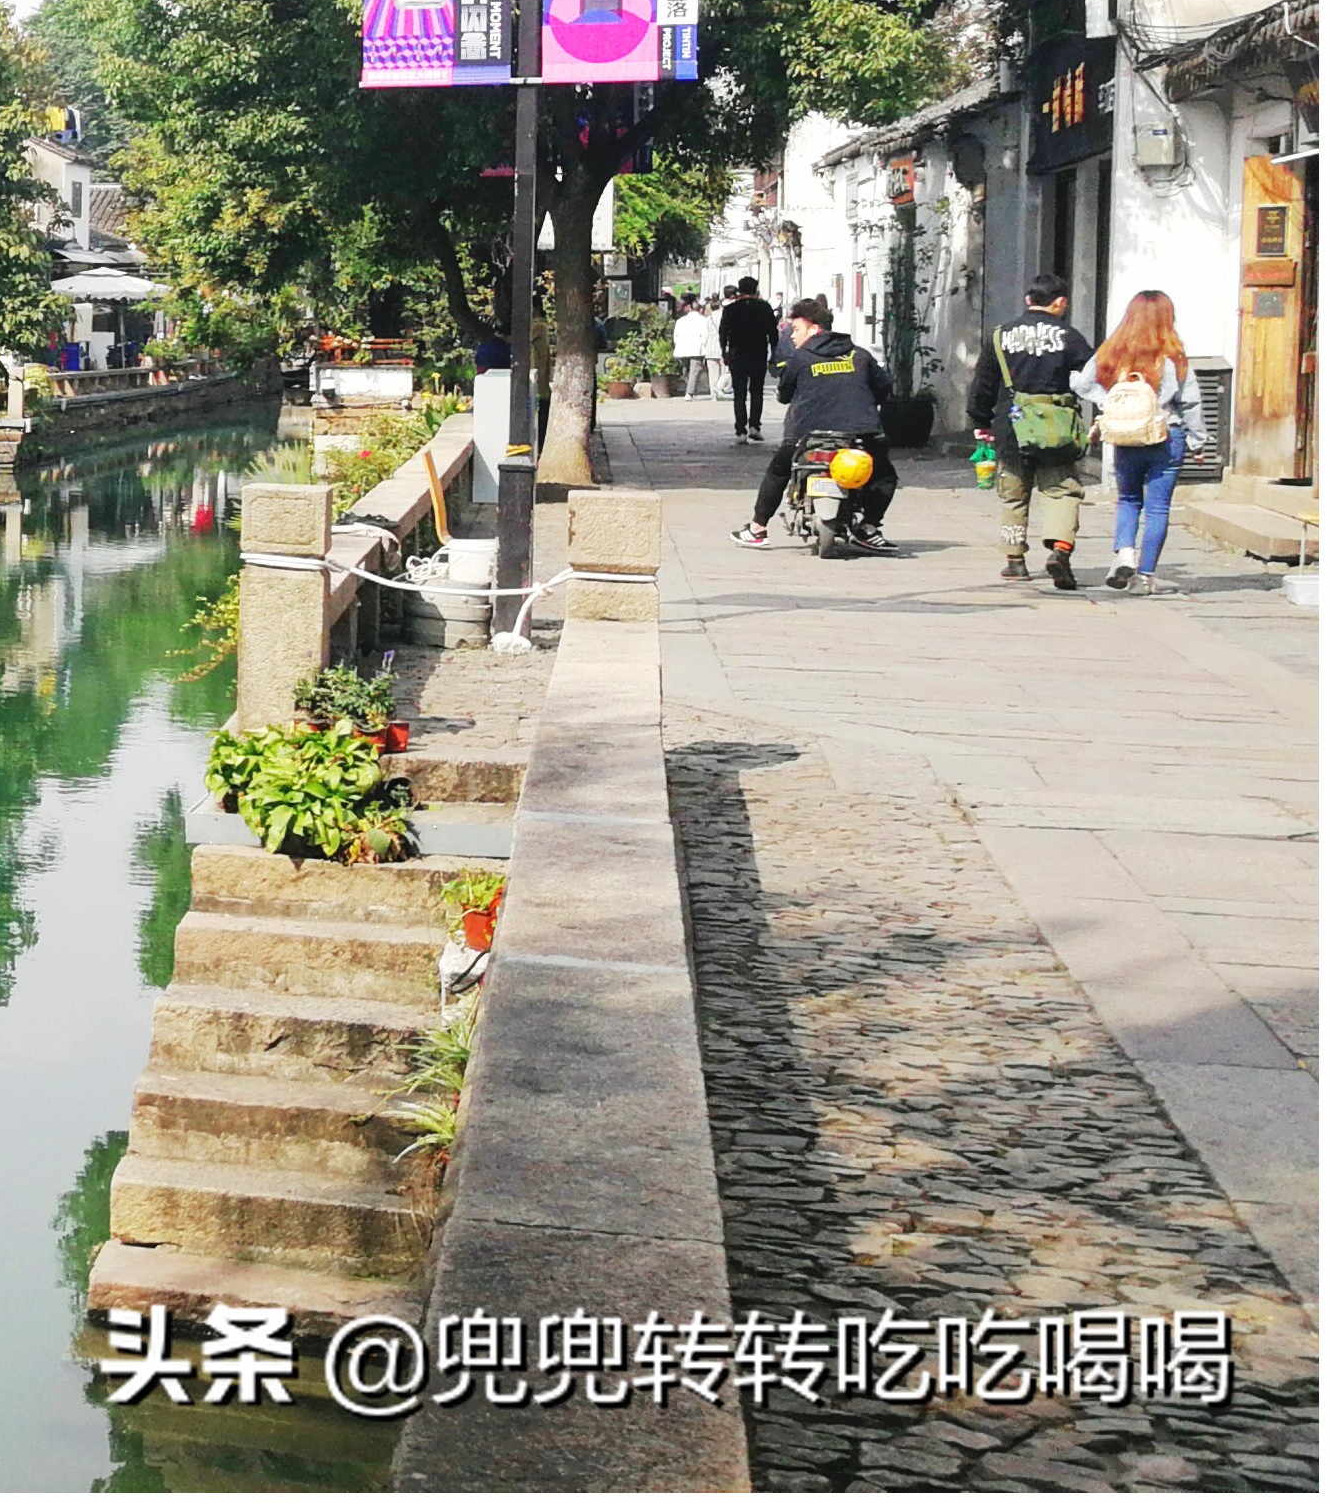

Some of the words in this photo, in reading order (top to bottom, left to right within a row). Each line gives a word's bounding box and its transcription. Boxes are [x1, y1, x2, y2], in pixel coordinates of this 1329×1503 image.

[489, 3, 503, 60] MOMENT
[662, 27, 673, 71] PROJECT
[681, 27, 692, 59] TINTIN
